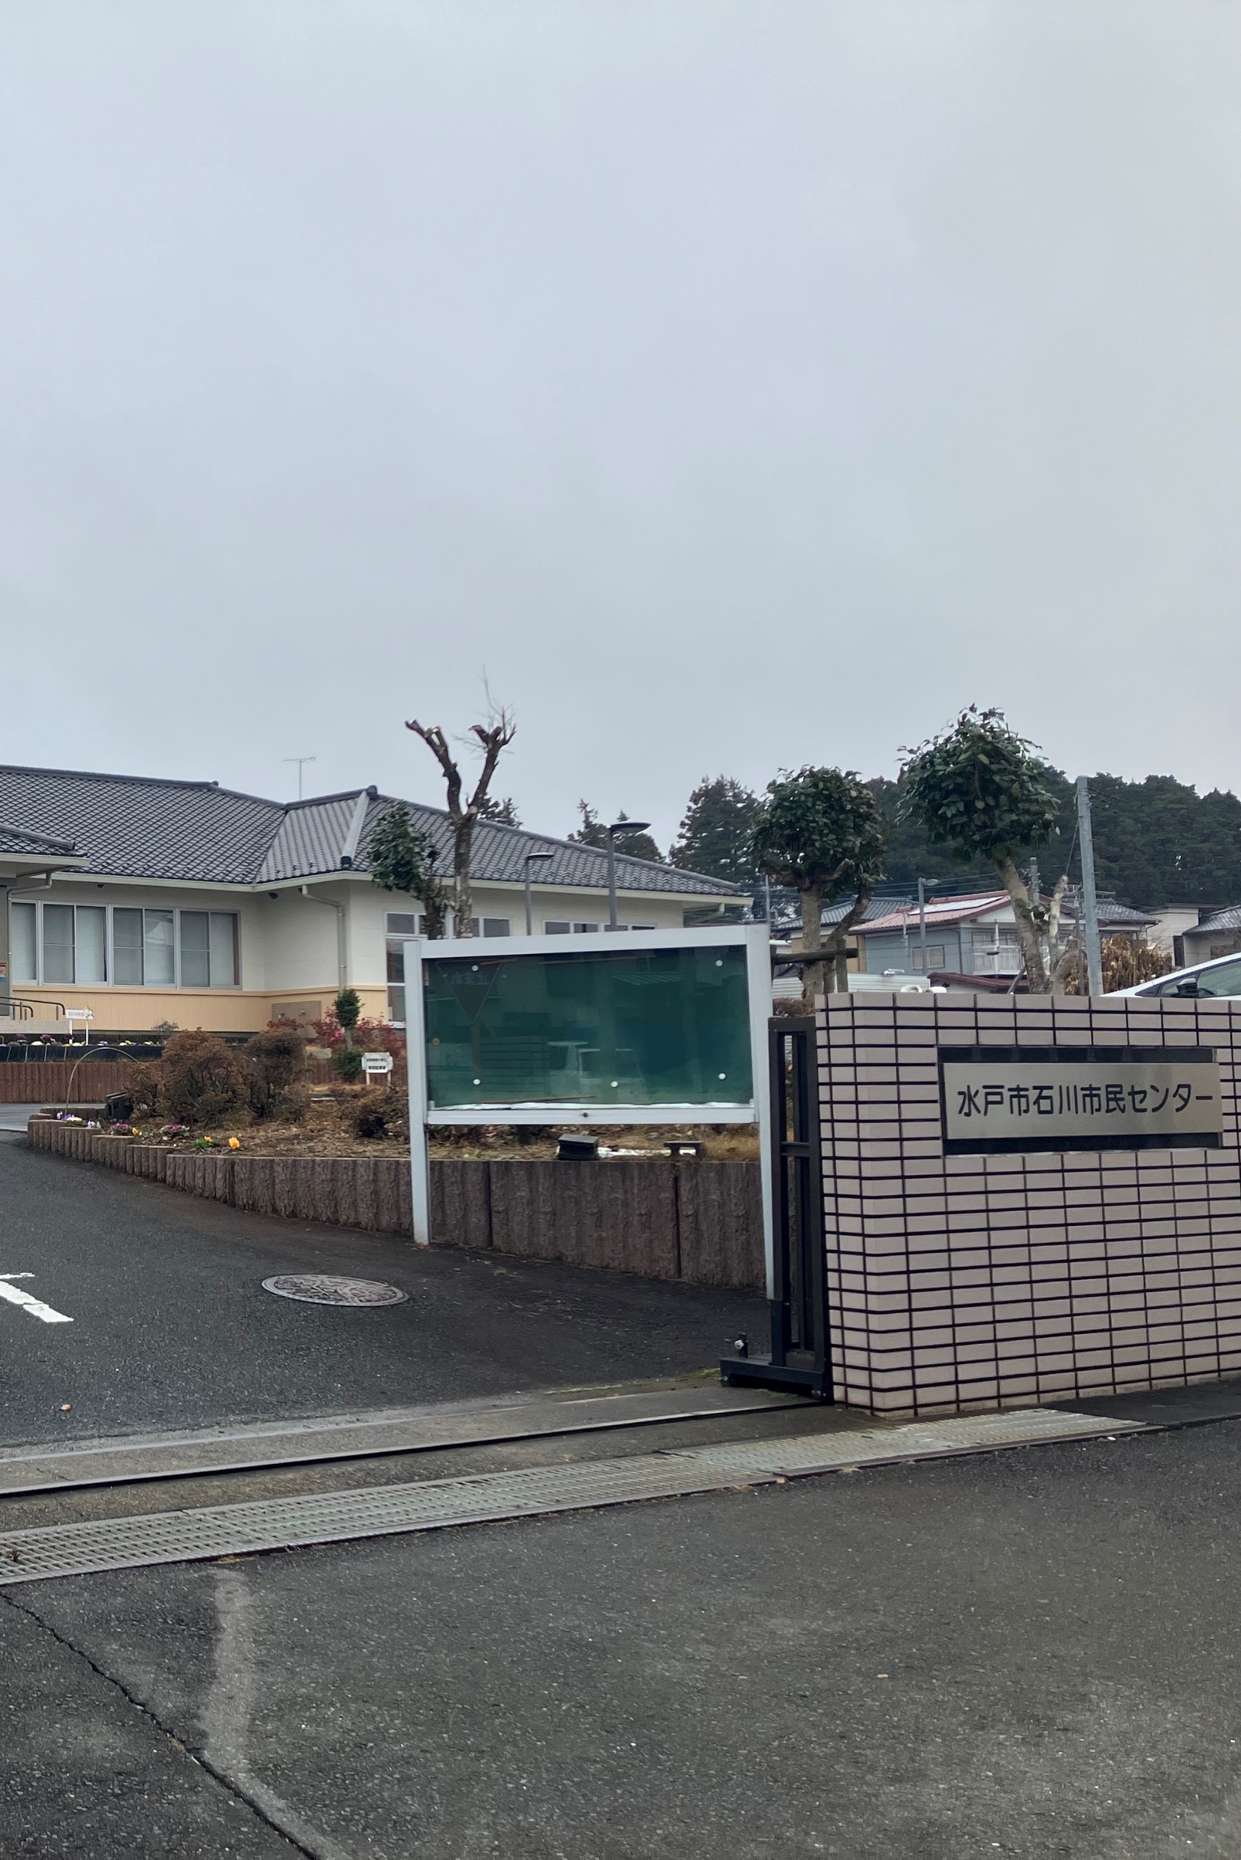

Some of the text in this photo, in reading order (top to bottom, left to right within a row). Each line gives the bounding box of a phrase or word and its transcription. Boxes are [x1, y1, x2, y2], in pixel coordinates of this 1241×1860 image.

[957, 1083, 1213, 1117] 水戸市石川市民センター
